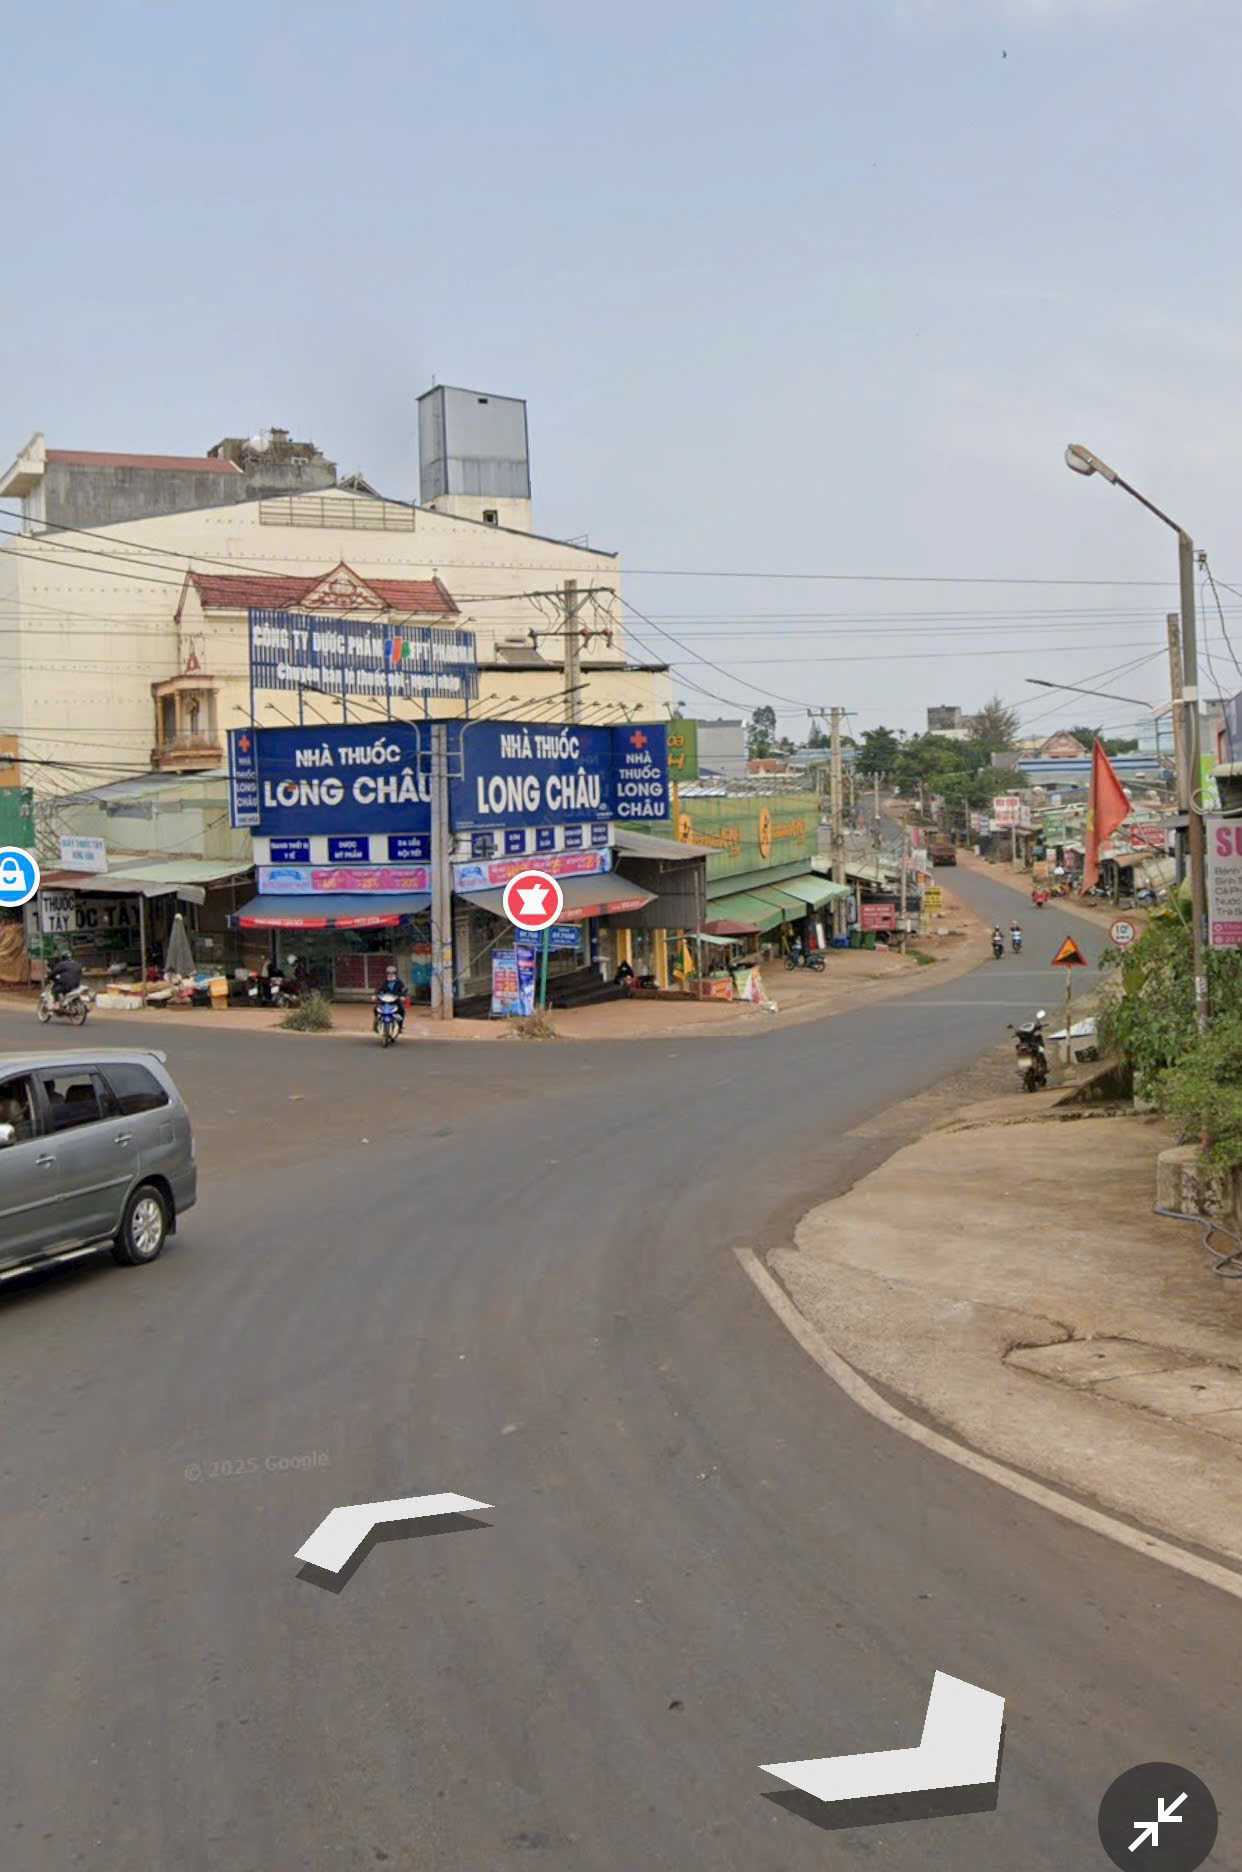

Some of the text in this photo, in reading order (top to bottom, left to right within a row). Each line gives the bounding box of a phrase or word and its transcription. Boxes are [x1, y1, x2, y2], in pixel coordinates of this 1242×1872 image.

[292, 629, 308, 651] TY
[295, 736, 401, 769] NHÀ THUỐC
[500, 726, 581, 760] NHÀ THUỐC
[625, 749, 653, 765] NHÀ
[618, 763, 662, 780] THUỐC
[263, 767, 433, 808] LONG CHÂU
[476, 764, 601, 815] LONG CHÂU
[616, 781, 664, 798] LONG
[616, 798, 666, 817] CHÂU
